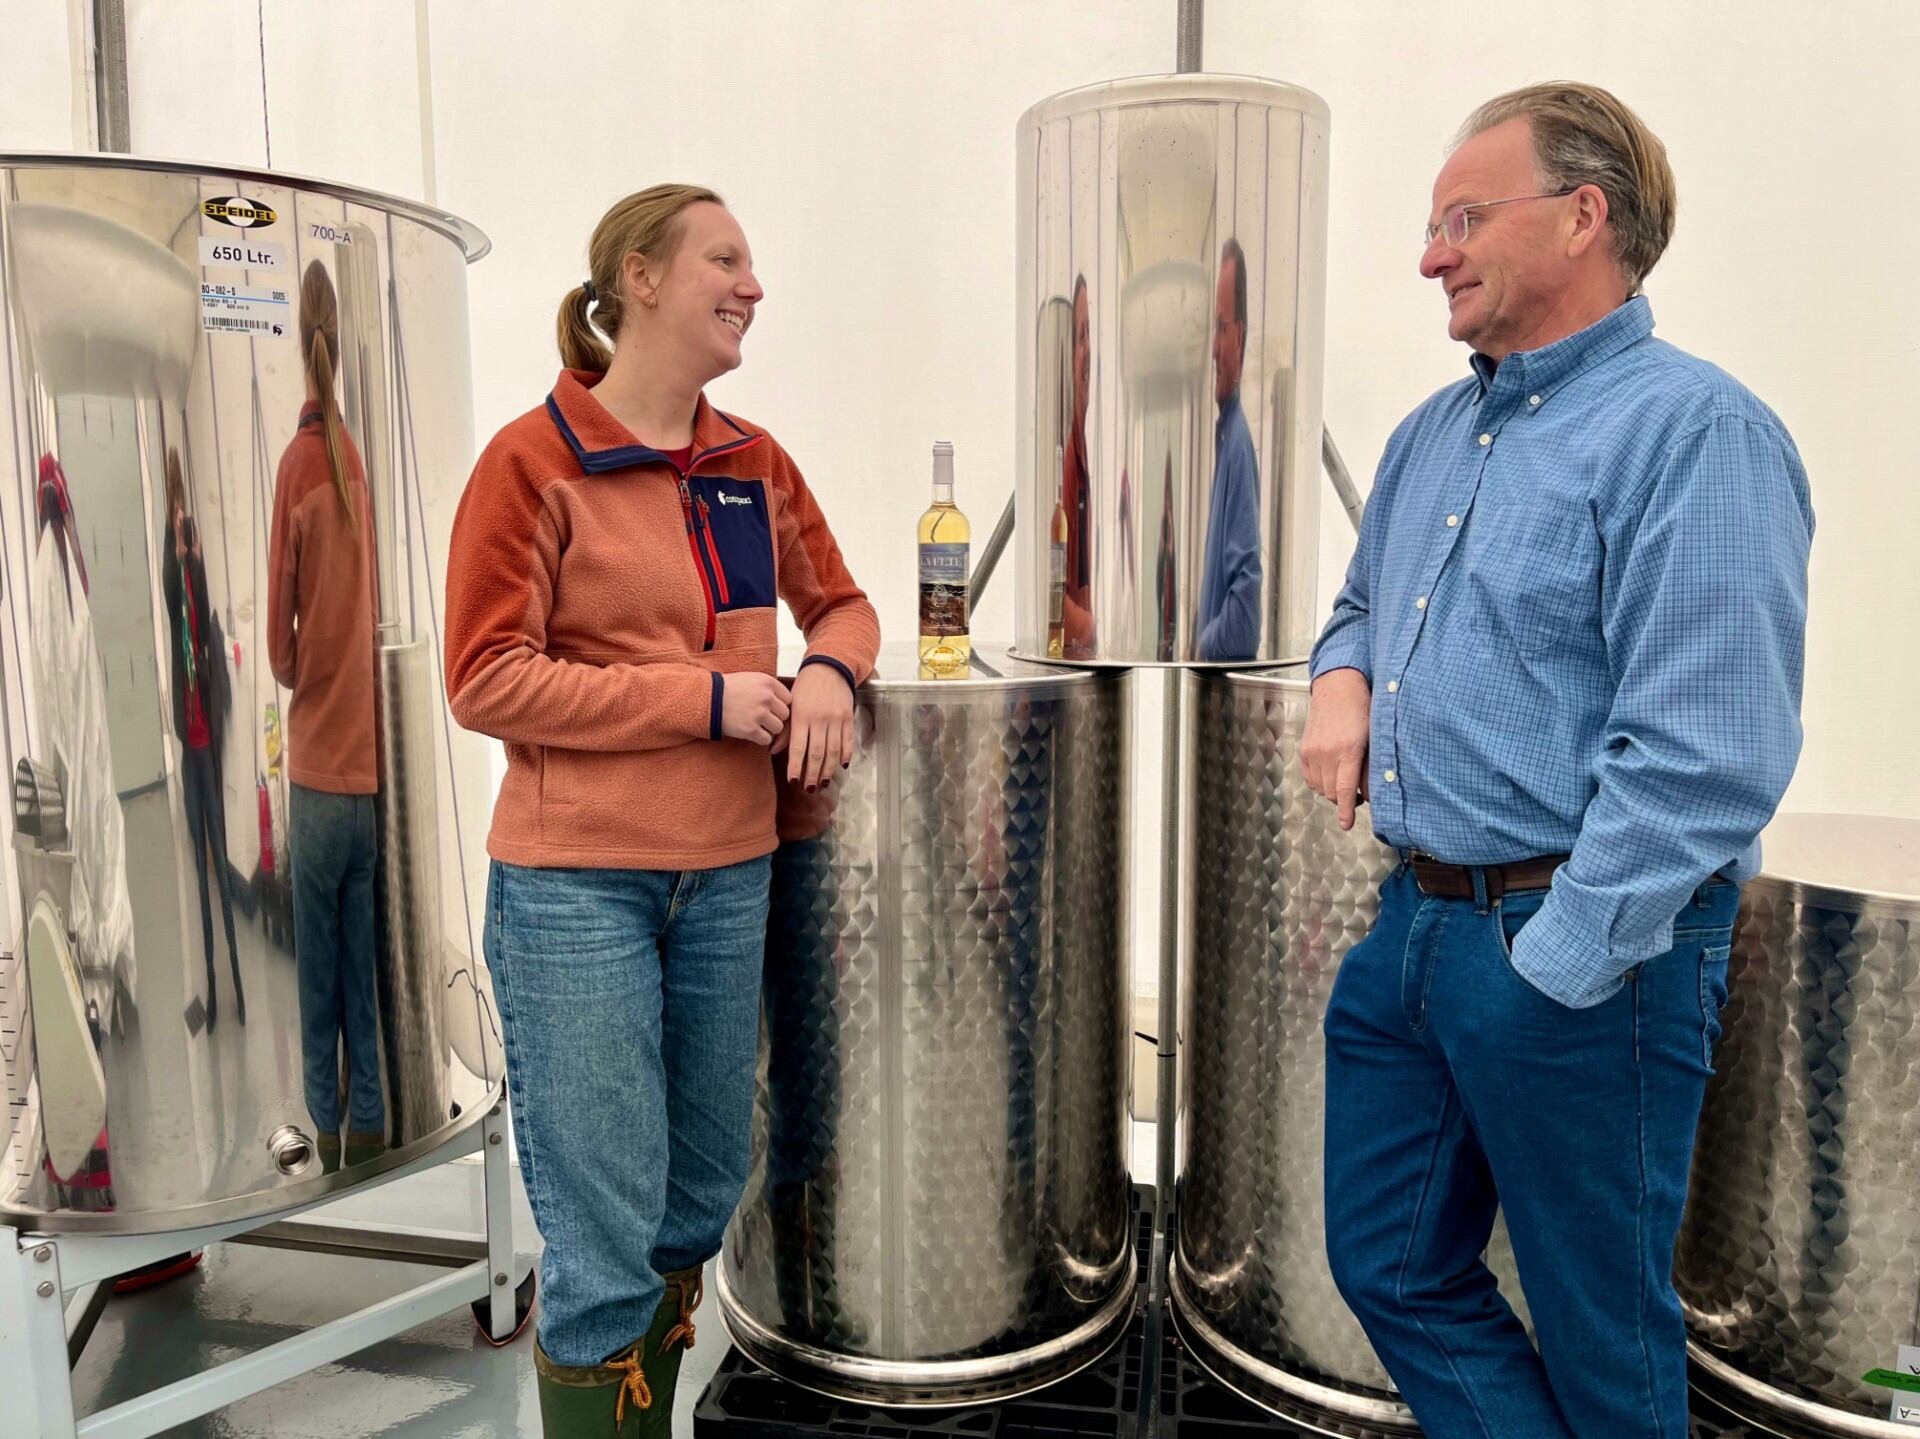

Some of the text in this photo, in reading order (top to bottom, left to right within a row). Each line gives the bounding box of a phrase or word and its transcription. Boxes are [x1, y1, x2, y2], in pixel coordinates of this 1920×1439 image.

[204, 204, 275, 221] SPEIDEL
[311, 224, 351, 244] 700-A
[212, 245, 274, 265] 650 Ltr.
